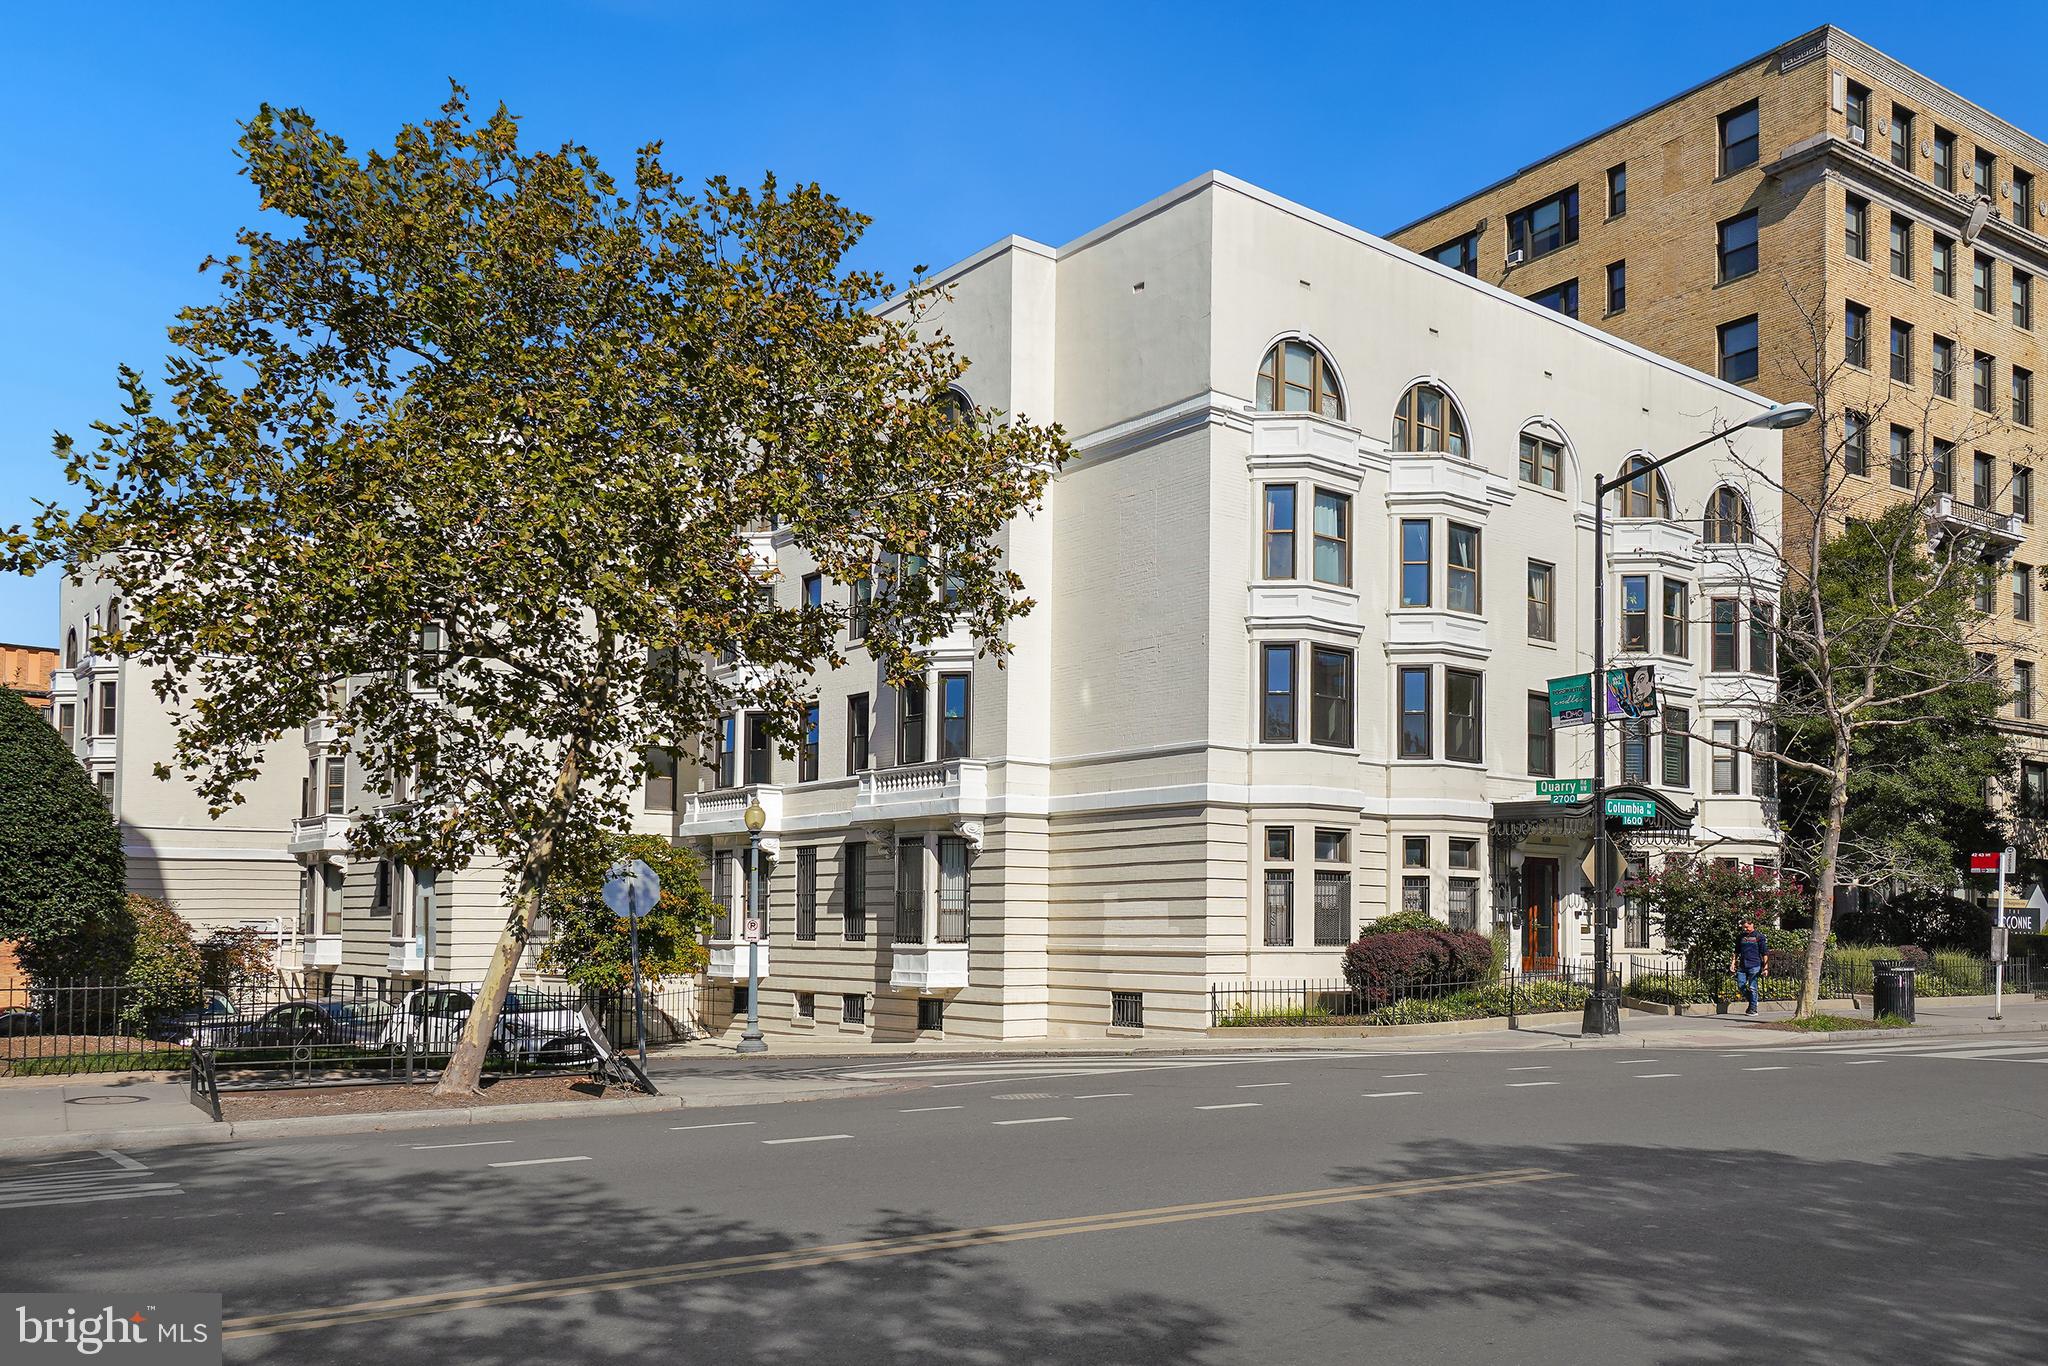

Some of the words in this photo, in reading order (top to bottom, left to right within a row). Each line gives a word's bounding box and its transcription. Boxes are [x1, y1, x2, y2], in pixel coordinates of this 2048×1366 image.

[1541, 781, 1576, 793] Quarry
[1553, 795, 1576, 803] 2700
[1607, 801, 1644, 814] Columbia
[1624, 817, 1643, 825] 1600
